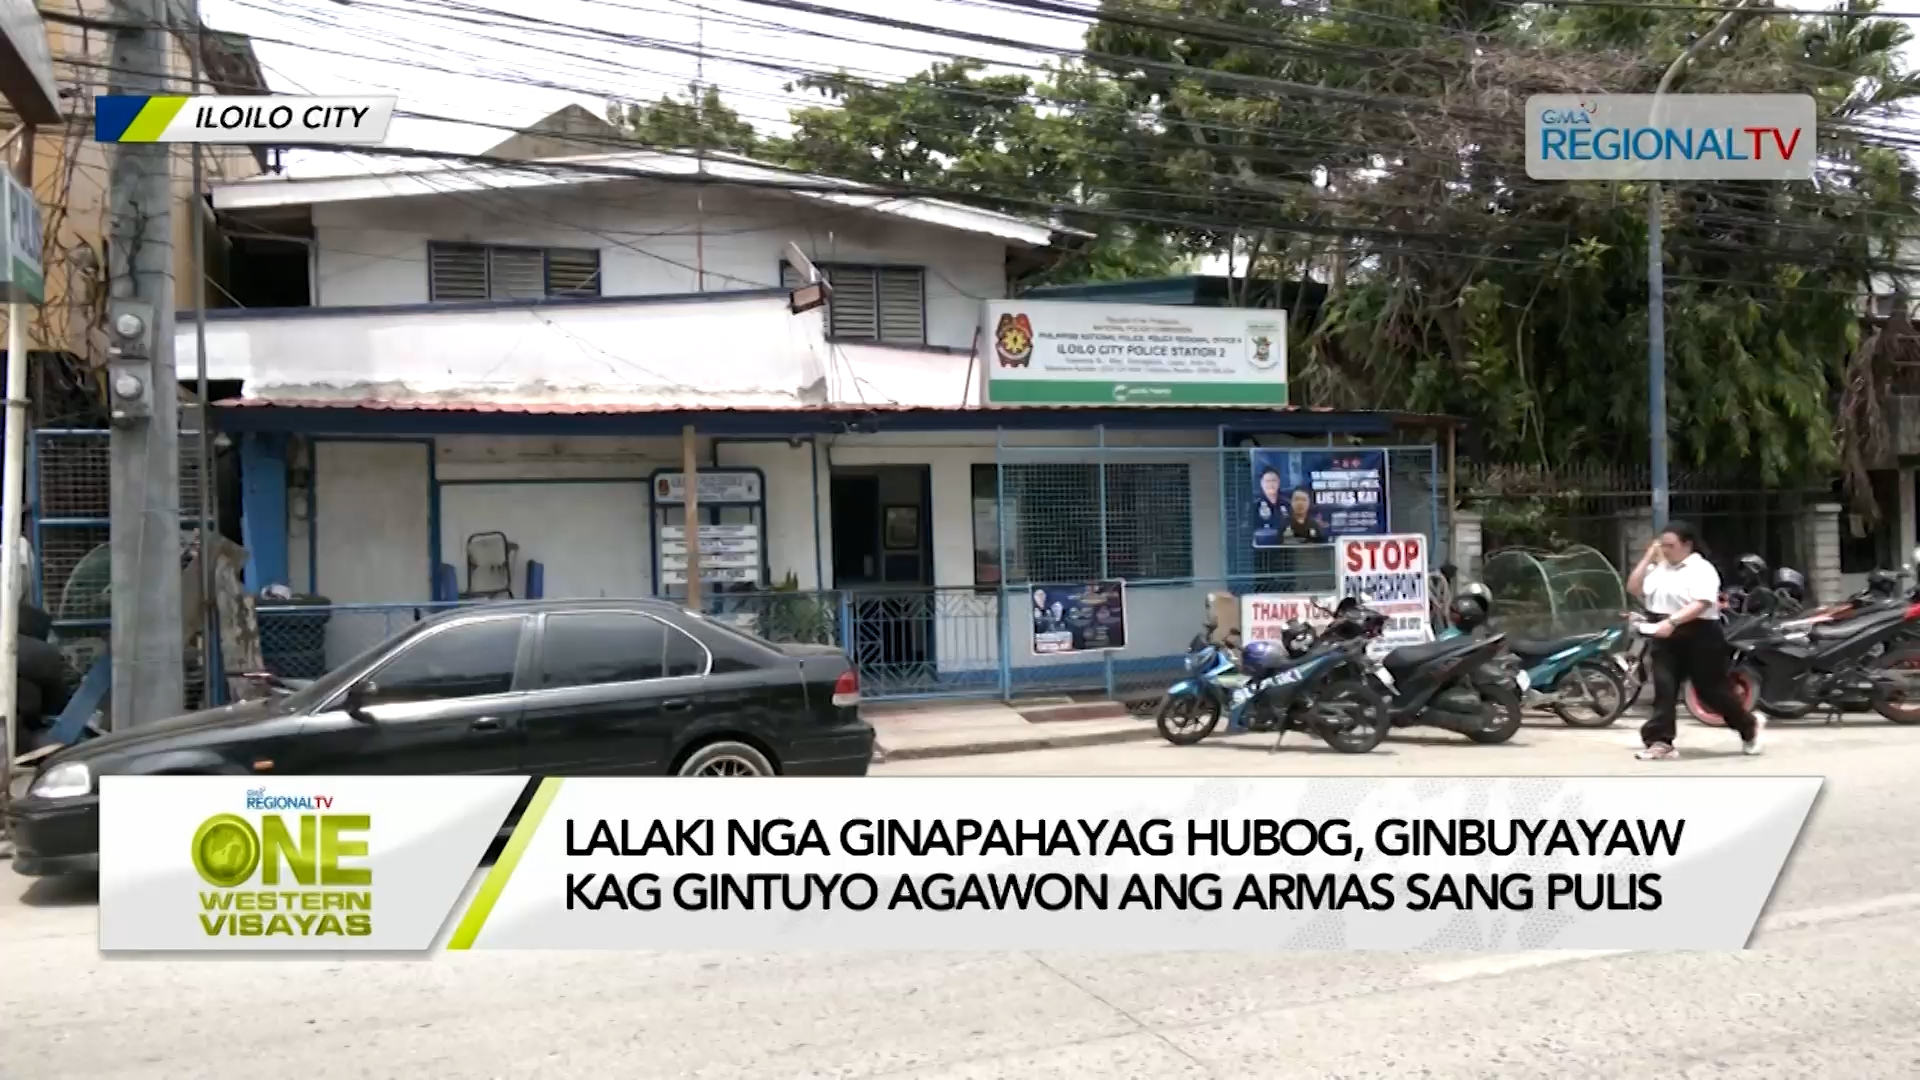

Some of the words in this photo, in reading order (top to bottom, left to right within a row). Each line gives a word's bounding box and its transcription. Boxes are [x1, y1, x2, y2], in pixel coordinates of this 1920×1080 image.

[1057, 343, 1096, 355] ILOILO
[1098, 344, 1125, 355] CITY
[1127, 345, 1168, 356] POLICE
[1171, 346, 1217, 357] STATION
[1218, 347, 1226, 358] 2
[1346, 540, 1419, 572] STOP
[1252, 603, 1299, 621] THANK
